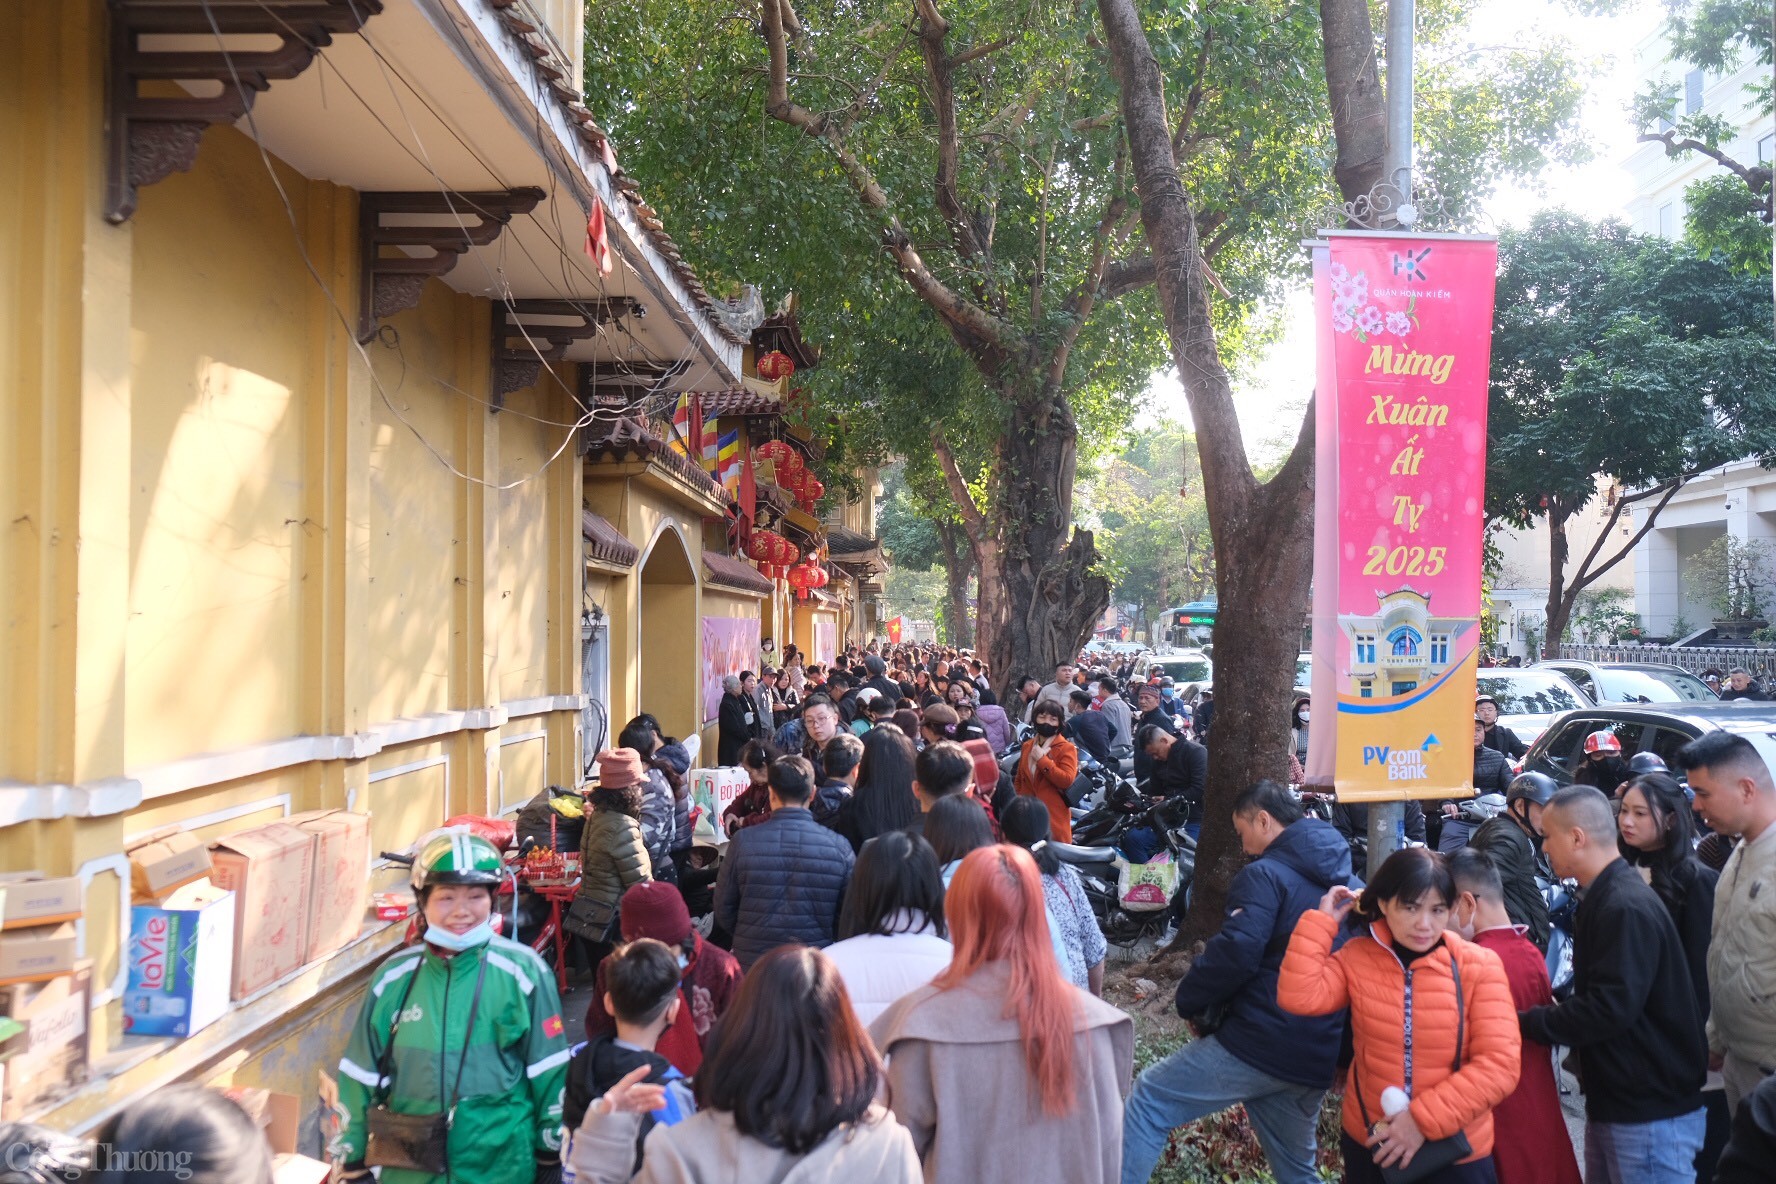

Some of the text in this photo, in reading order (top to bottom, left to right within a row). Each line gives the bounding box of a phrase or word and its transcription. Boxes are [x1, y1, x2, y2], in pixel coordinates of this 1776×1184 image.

[1364, 342, 1455, 385] Mừng
[1366, 394, 1449, 427] Xuân
[1389, 433, 1425, 476] Ất
[1392, 495, 1425, 534] Tỵ
[1362, 545, 1447, 577] 2025
[1363, 745, 1421, 766] PVcom
[1388, 764, 1428, 781] Bank
[720, 779, 733, 801] BÒ
